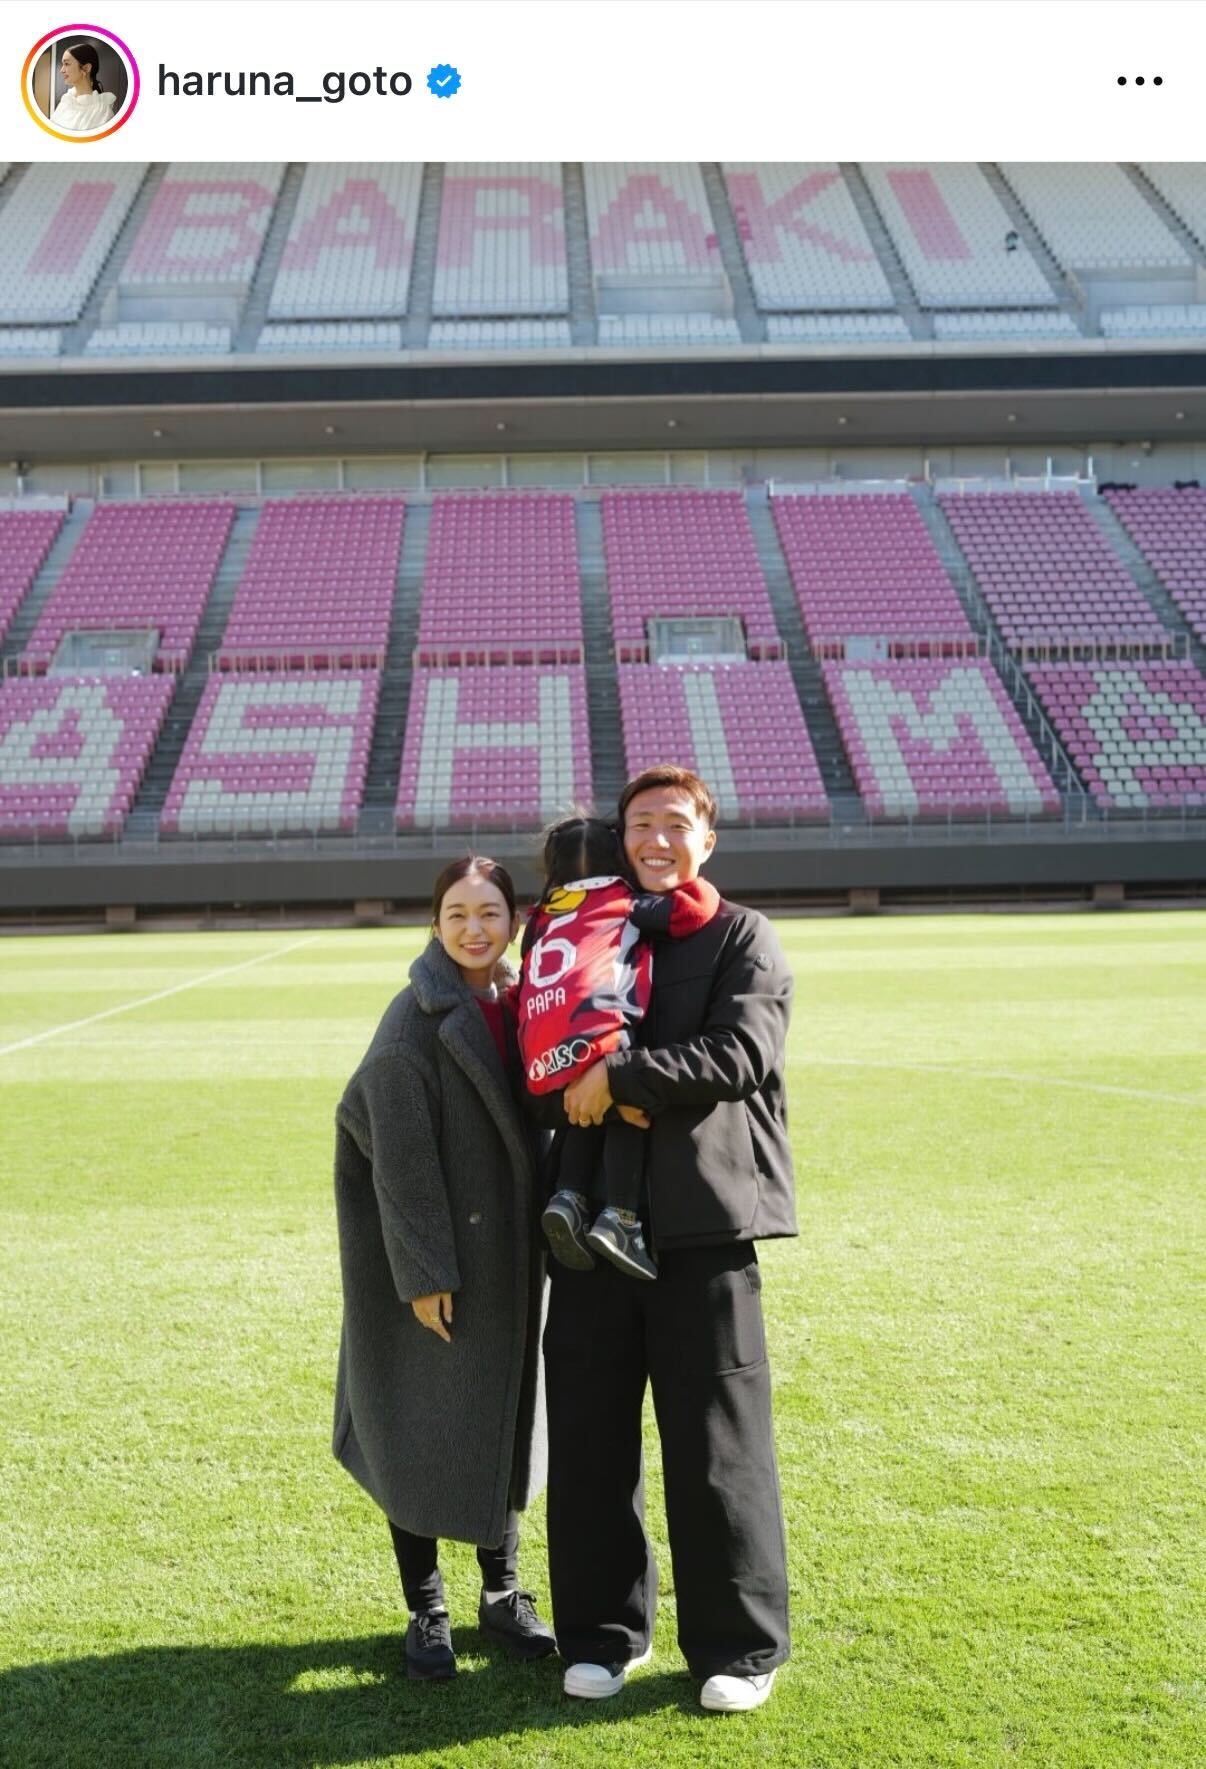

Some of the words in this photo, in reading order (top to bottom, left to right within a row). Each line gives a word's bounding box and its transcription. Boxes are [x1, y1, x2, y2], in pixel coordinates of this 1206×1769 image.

[23, 168, 974, 276] IBARAKI
[528, 911, 579, 988] 6
[526, 986, 566, 1020] PAPA
[541, 1038, 592, 1075] RISO
